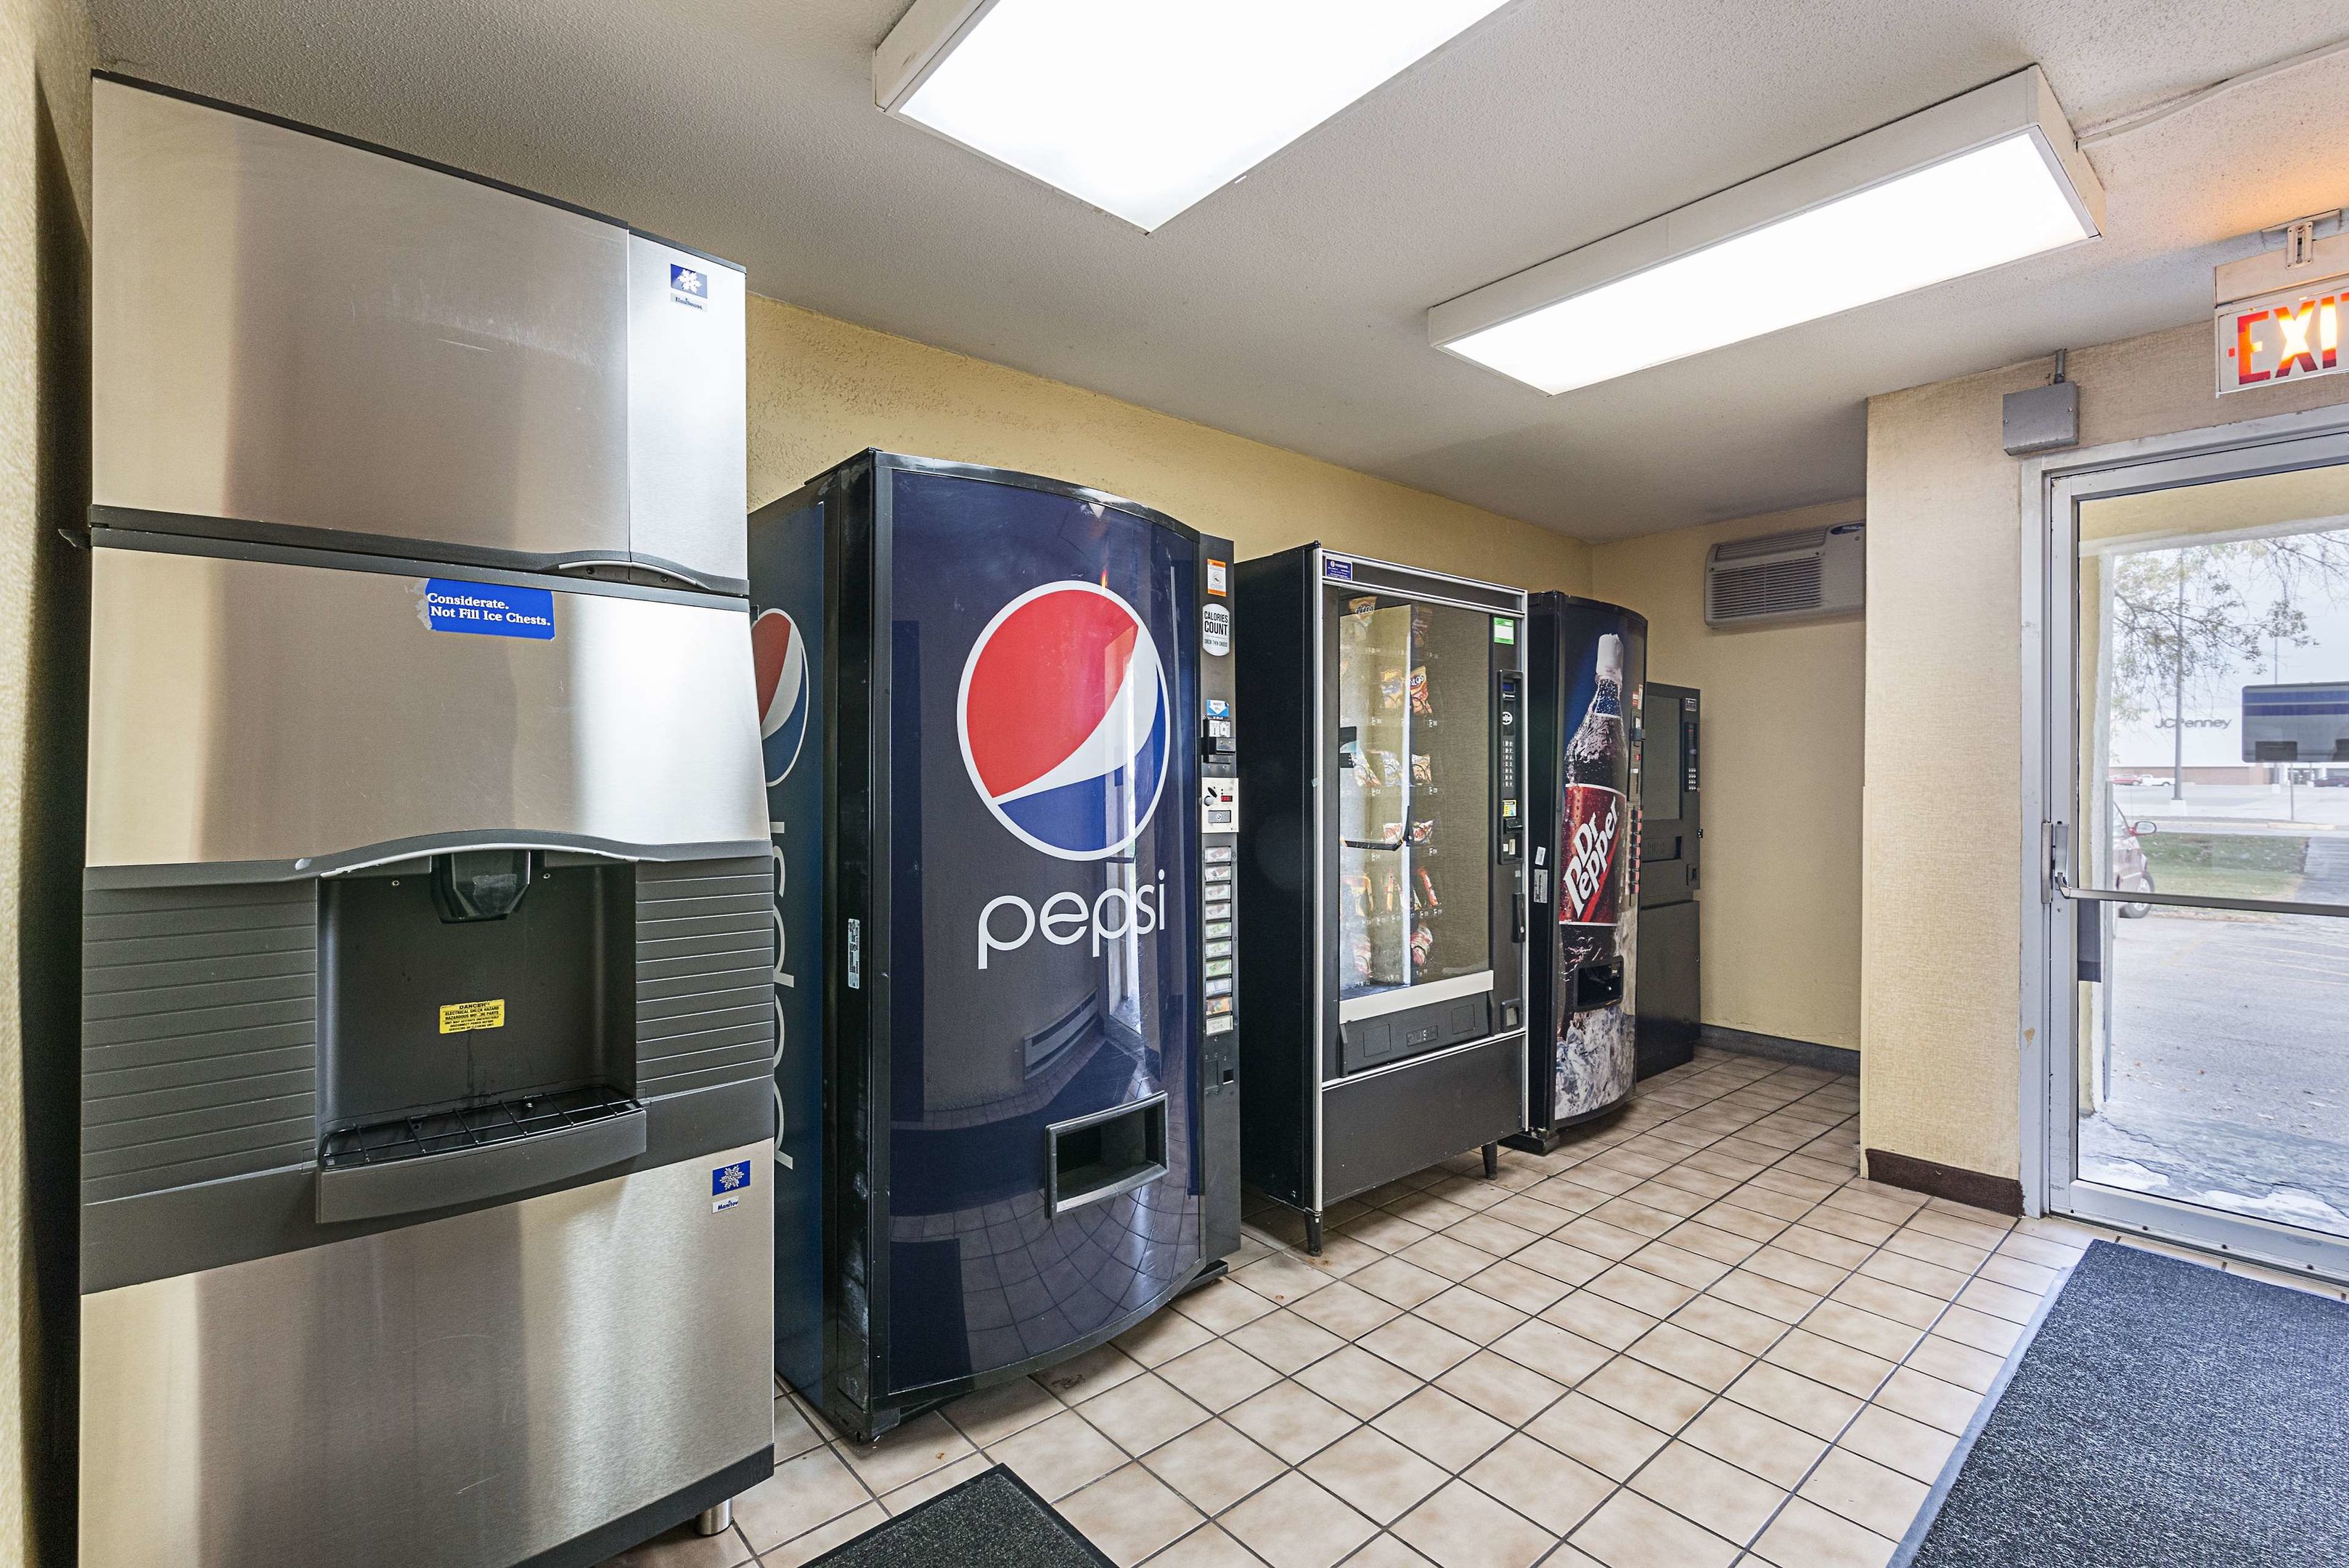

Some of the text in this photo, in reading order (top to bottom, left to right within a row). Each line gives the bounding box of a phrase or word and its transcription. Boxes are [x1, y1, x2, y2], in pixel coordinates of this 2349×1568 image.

[2237, 292, 2349, 385] EXI
[427, 592, 510, 610] Considerate.
[430, 605, 552, 626] Not Fill Ice Chests.
[1204, 611, 1228, 624] CALORIES
[1204, 621, 1228, 636] COUNT
[1563, 796, 1618, 918] Dr Pepper
[978, 869, 1165, 970] pepsi
